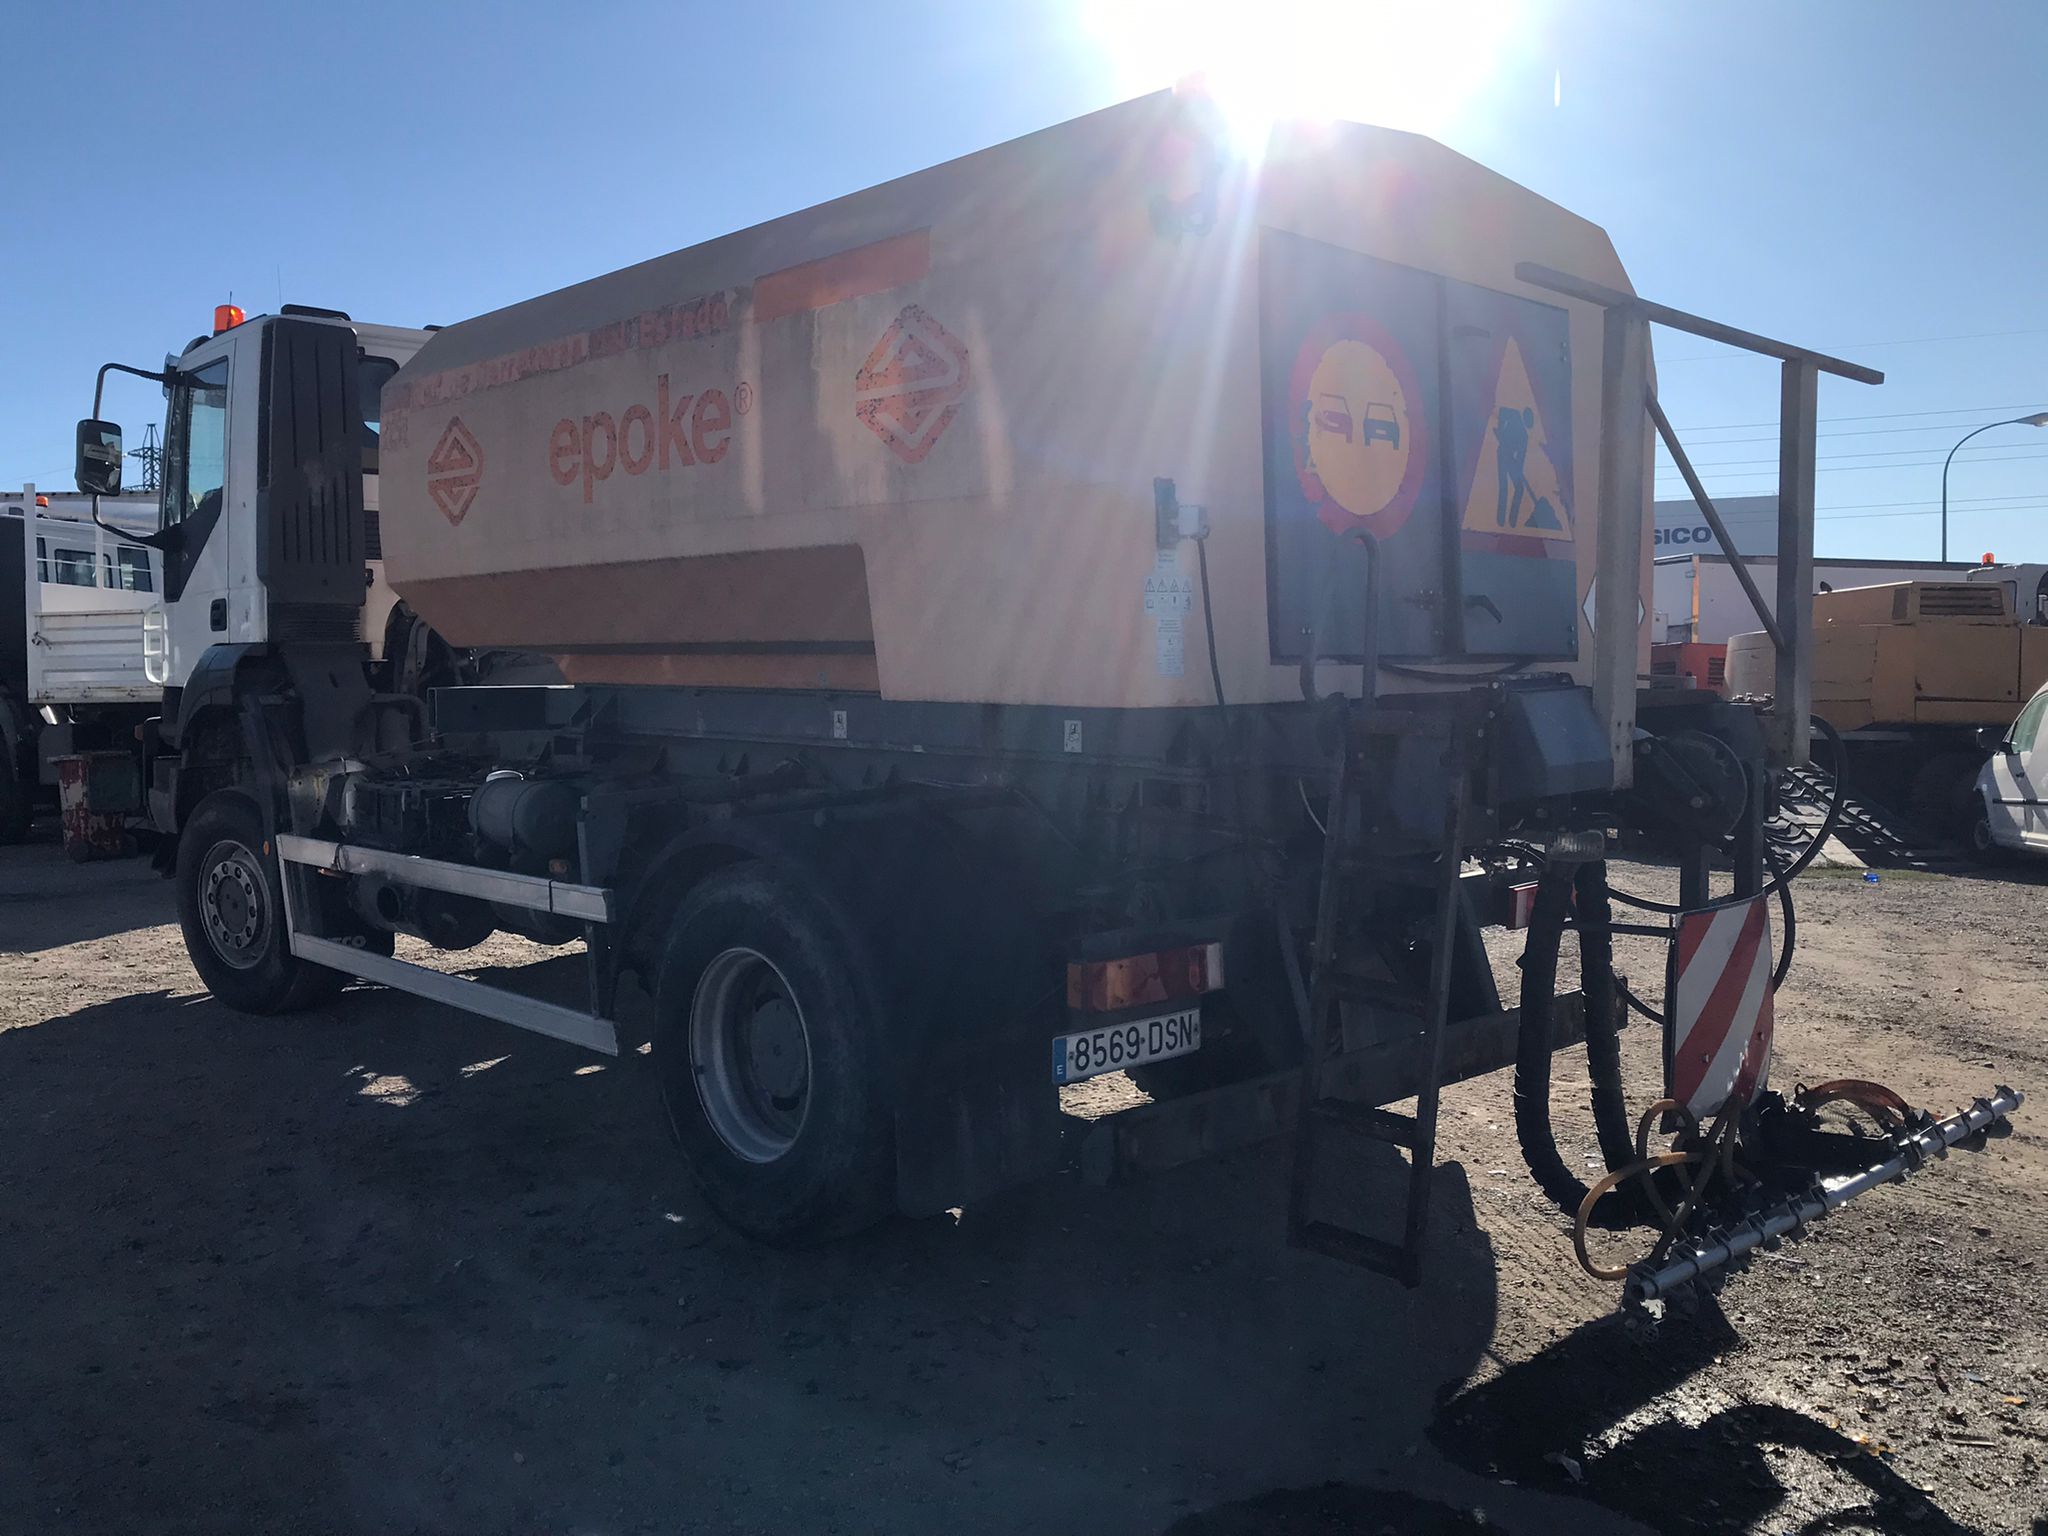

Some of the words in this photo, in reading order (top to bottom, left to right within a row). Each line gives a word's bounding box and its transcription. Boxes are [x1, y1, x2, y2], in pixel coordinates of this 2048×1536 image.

[1075, 1026, 1140, 1071] 8569
[1148, 1014, 1193, 1055] DSN
[1056, 1064, 1064, 1075] E
